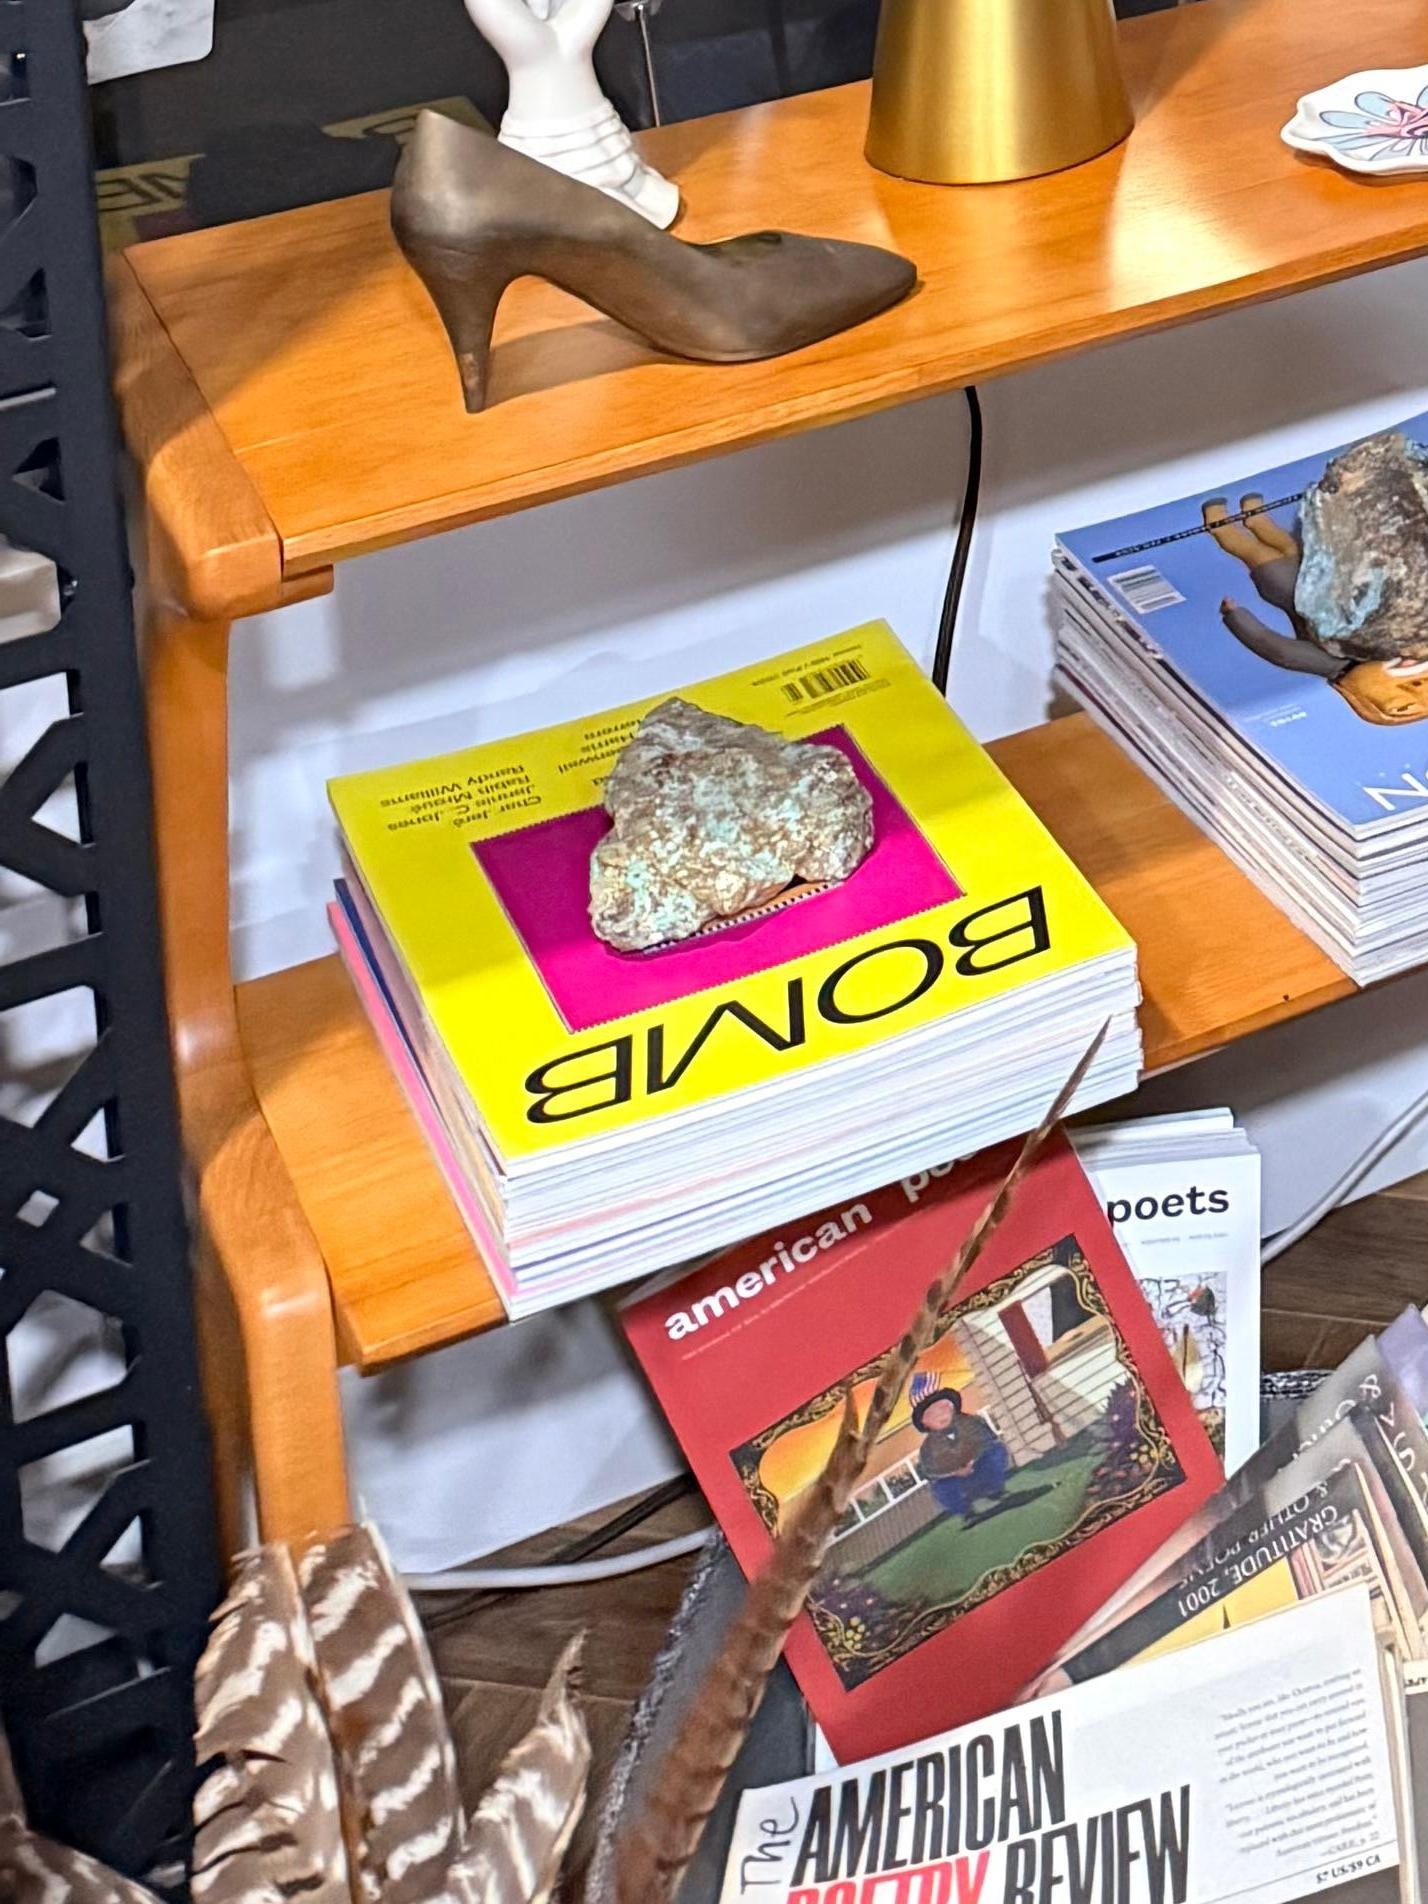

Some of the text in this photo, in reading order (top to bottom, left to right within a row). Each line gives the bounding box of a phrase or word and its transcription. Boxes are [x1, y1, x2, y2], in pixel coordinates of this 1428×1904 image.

[380, 764, 525, 808] Randy Williams
[387, 811, 443, 830] Jones
[522, 884, 1054, 1128] BOMB
[1105, 1183, 1231, 1225] poets
[662, 1199, 874, 1342] american
[1177, 1503, 1338, 1617] GRATITUDE, 2001
[1248, 1480, 1328, 1540] & OTHER
[740, 1796, 800, 1896] The
[790, 1708, 1067, 1886] AMERICAN
[1000, 1783, 1191, 1904] REVIEW
